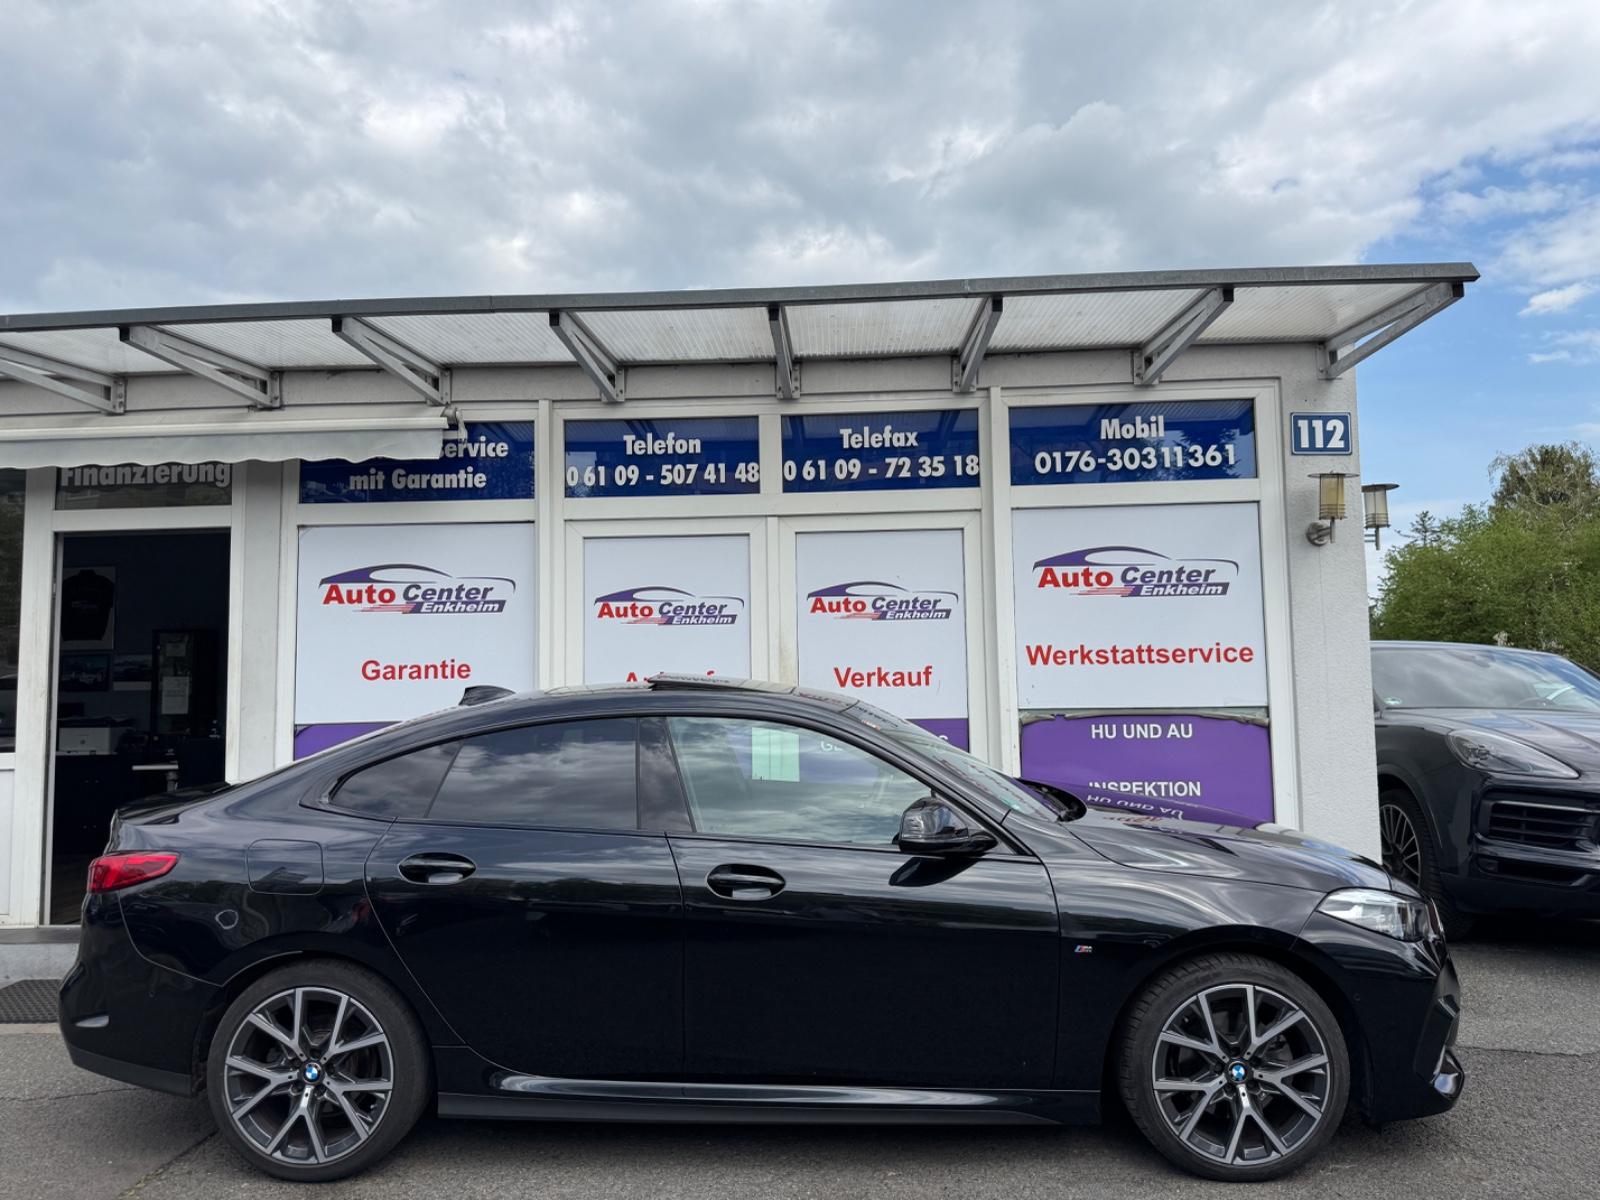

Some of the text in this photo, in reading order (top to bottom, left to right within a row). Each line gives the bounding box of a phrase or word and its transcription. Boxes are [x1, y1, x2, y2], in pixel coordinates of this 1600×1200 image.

[840, 425, 917, 448] Telefax
[1101, 415, 1164, 440] Mobil
[1298, 419, 1344, 448] 112
[440, 435, 509, 458] ervice
[623, 432, 700, 454] Telefon
[784, 461, 796, 480] 0
[803, 460, 825, 480] 61
[835, 459, 861, 479] 09
[886, 457, 910, 477] 72
[919, 456, 945, 476] 35
[955, 455, 980, 475] 18
[1035, 444, 1234, 473] 0176-30311361
[61, 463, 231, 488] Finanzierung
[349, 466, 487, 490] mit Garantie
[566, 466, 578, 486] 0
[584, 466, 605, 486] 61
[615, 465, 639, 485] 09
[661, 464, 698, 484] 507
[704, 464, 725, 483] 41
[735, 463, 760, 482] 48
[1038, 565, 1216, 588] Auto Center
[323, 583, 495, 605] Auto Center
[1139, 584, 1223, 597] Enkheim
[420, 602, 501, 614] Enkheim
[597, 601, 728, 619] Auto Center
[810, 596, 942, 614] Auto Center
[886, 610, 948, 620] Enkheim
[672, 615, 733, 625] Enkheim
[1026, 642, 1253, 666] Werkstattservice
[361, 660, 471, 681] Garantie
[834, 665, 932, 688] Verkauf
[1091, 723, 1193, 739] HU UND AU
